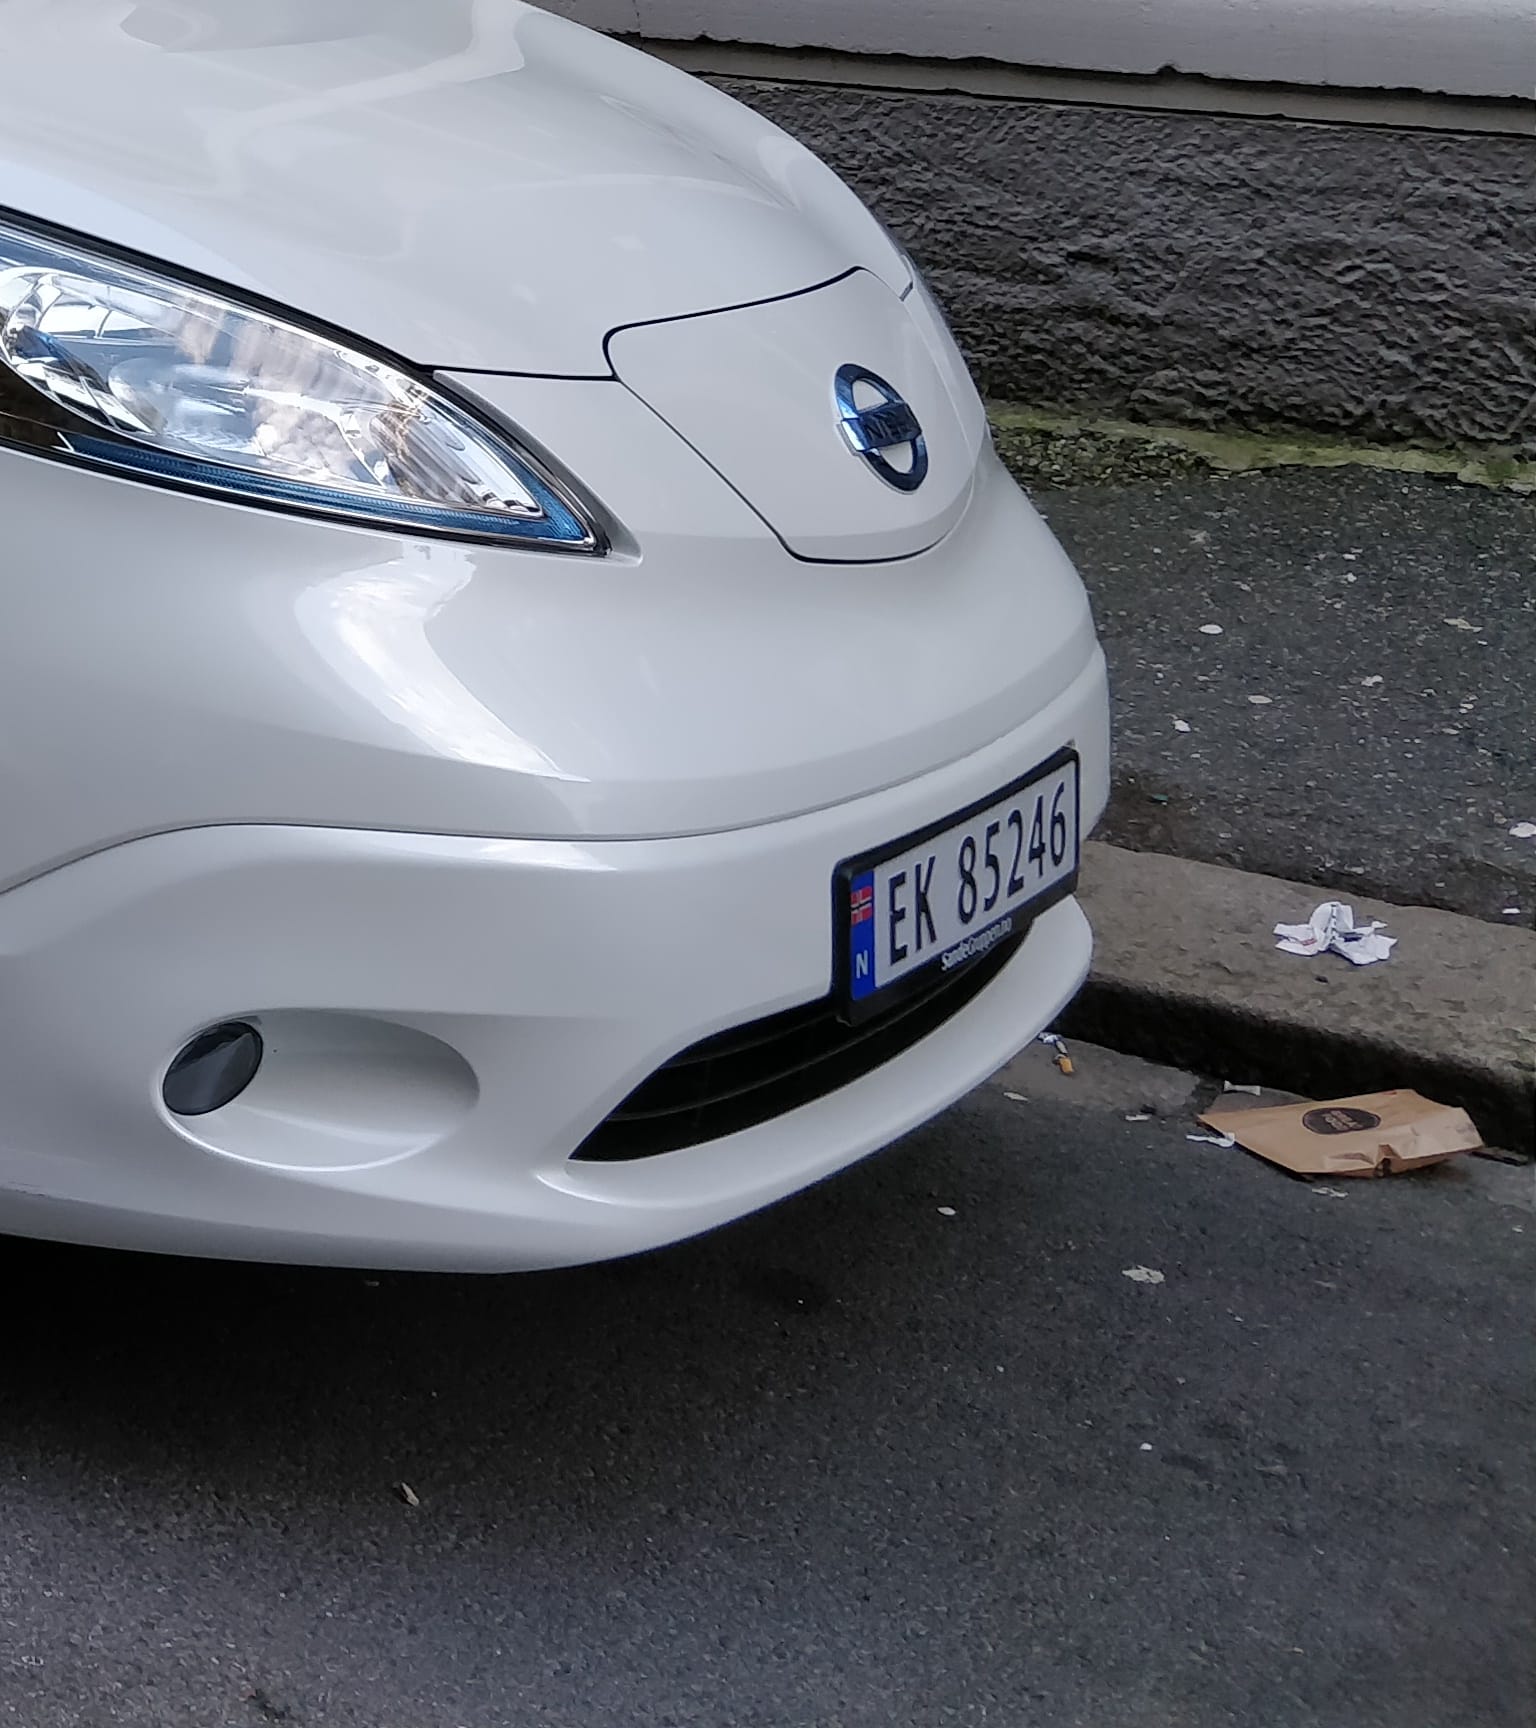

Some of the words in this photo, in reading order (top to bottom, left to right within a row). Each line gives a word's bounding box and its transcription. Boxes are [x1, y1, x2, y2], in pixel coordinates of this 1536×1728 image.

[888, 855, 937, 966] EK
[957, 781, 1067, 924] 85246
[855, 949, 869, 979] N
